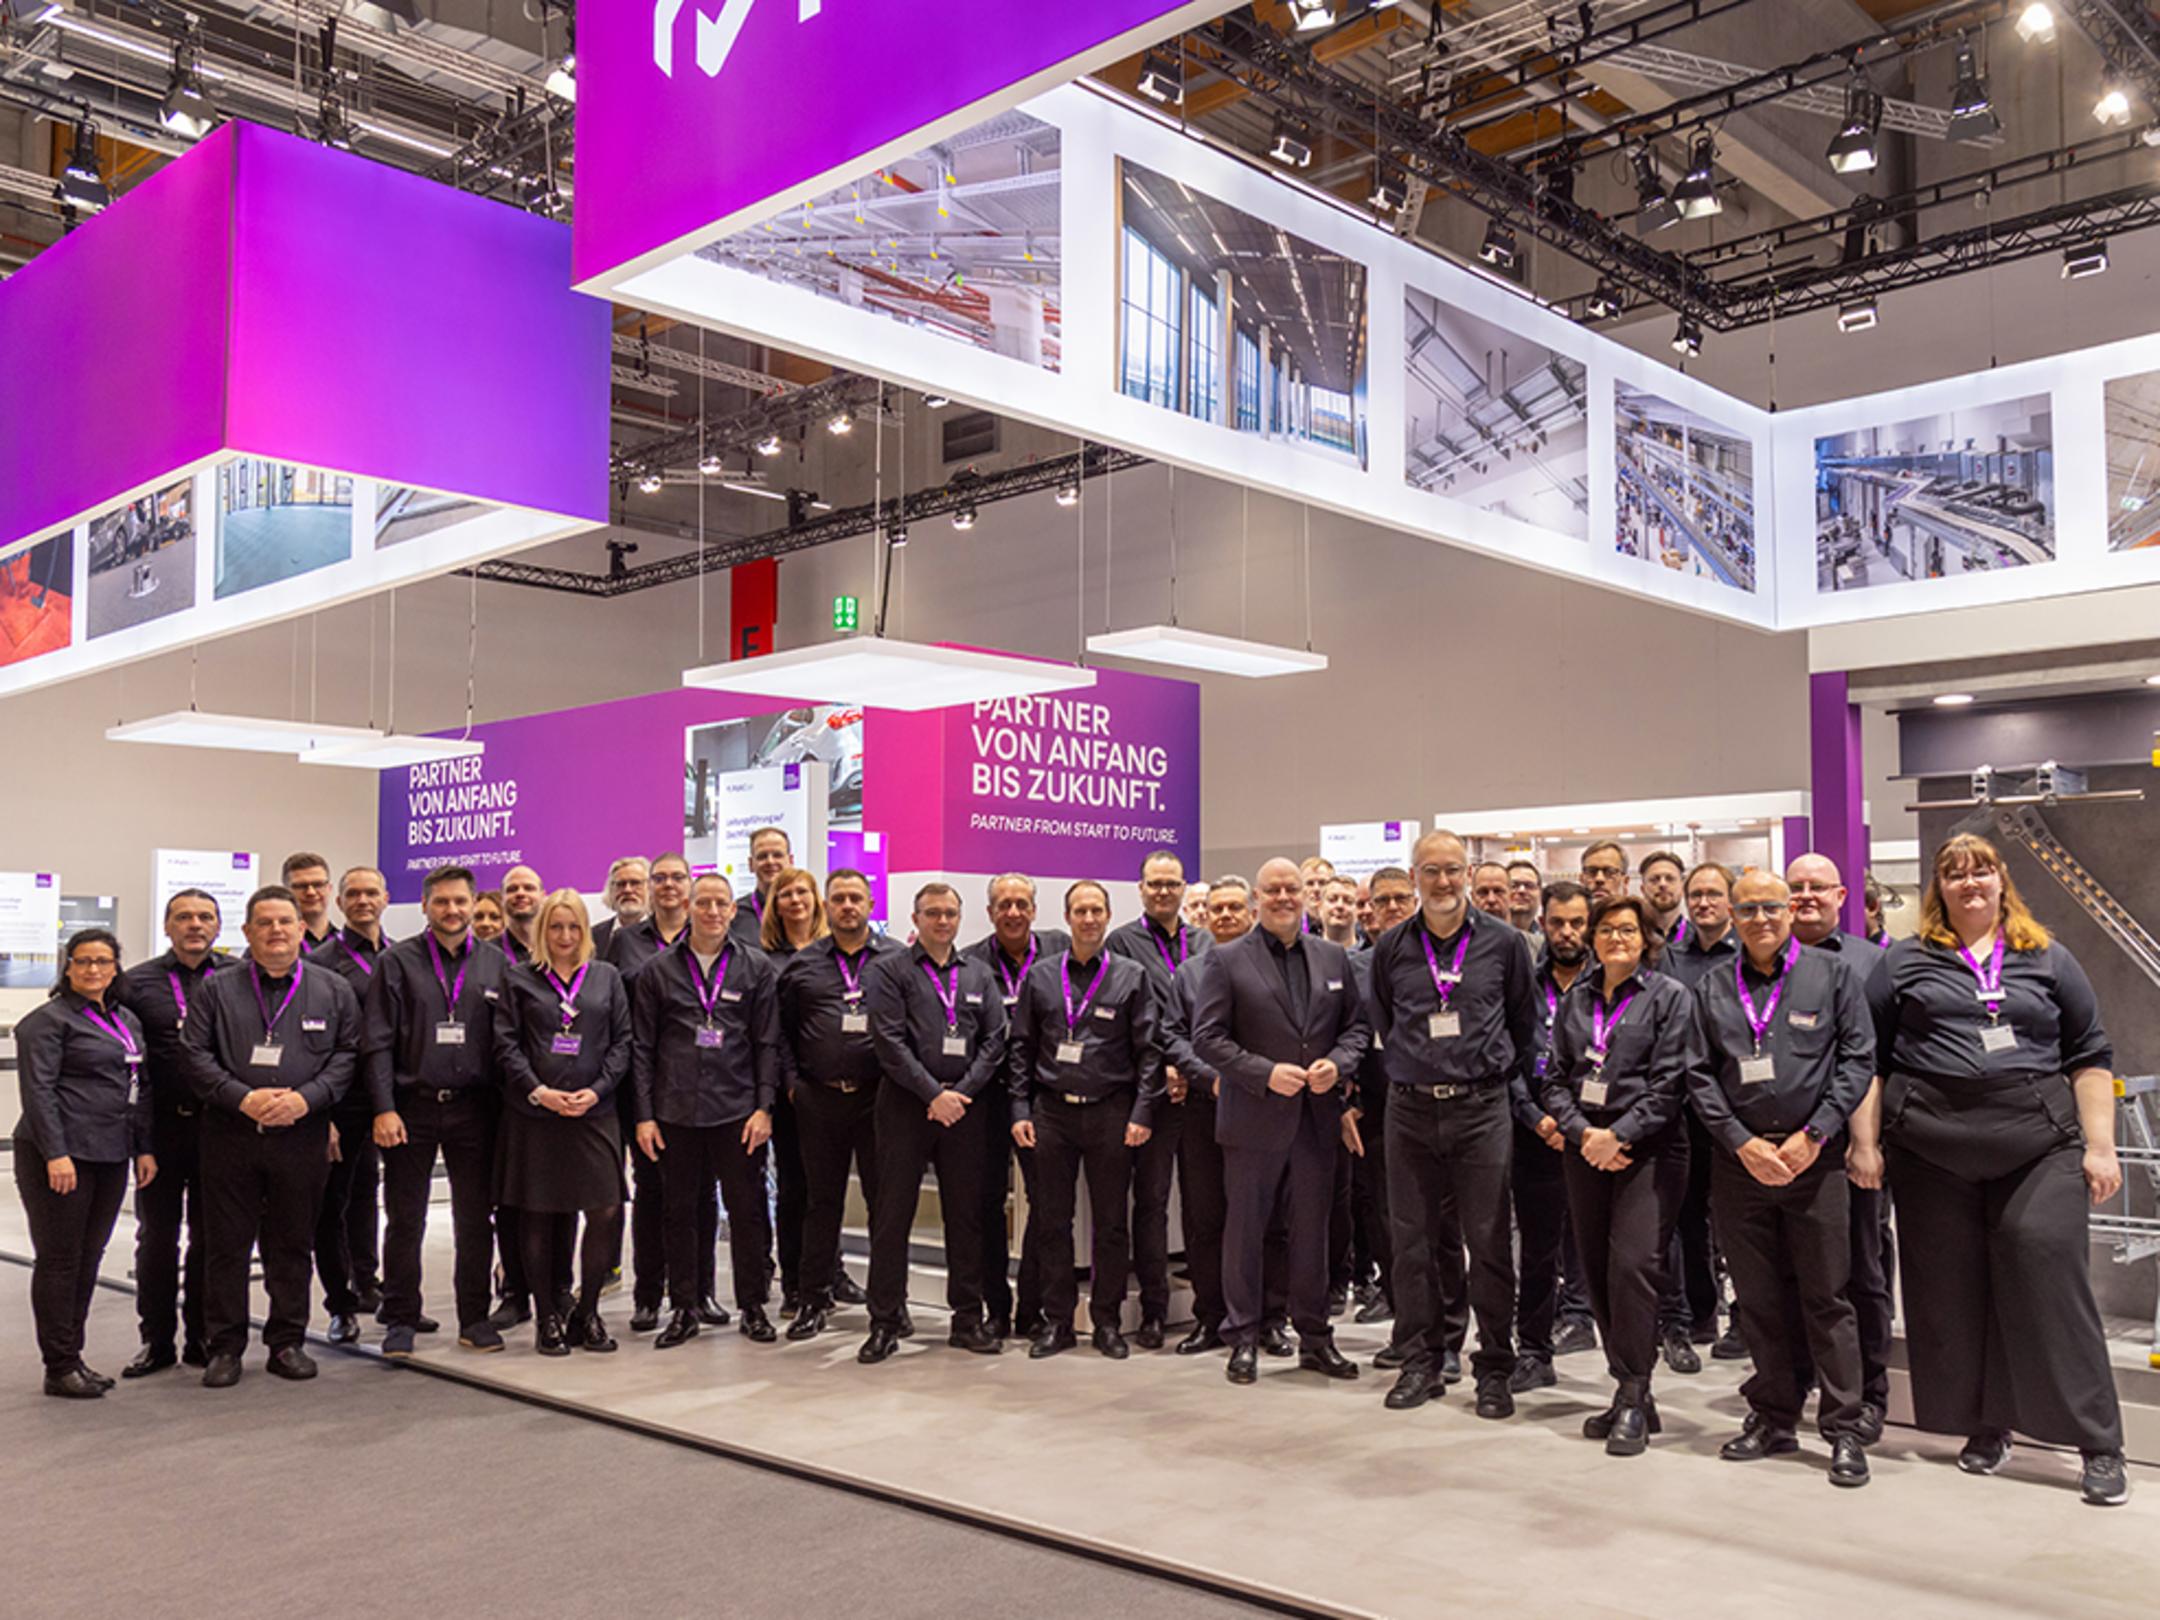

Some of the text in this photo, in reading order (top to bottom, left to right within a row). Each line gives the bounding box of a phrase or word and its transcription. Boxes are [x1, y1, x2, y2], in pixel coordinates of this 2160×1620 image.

[973, 695, 1111, 736] PARTNER
[971, 724, 1168, 777] VON ANFANG
[409, 756, 482, 790] PARTNER
[972, 762, 1166, 812] BIS ZUKUNFT.
[408, 780, 517, 817] VON ANFANG
[408, 810, 515, 846] BIS ZUKUNFT.
[970, 813, 1178, 844] PARTNER FROM START TO FUTURE.
